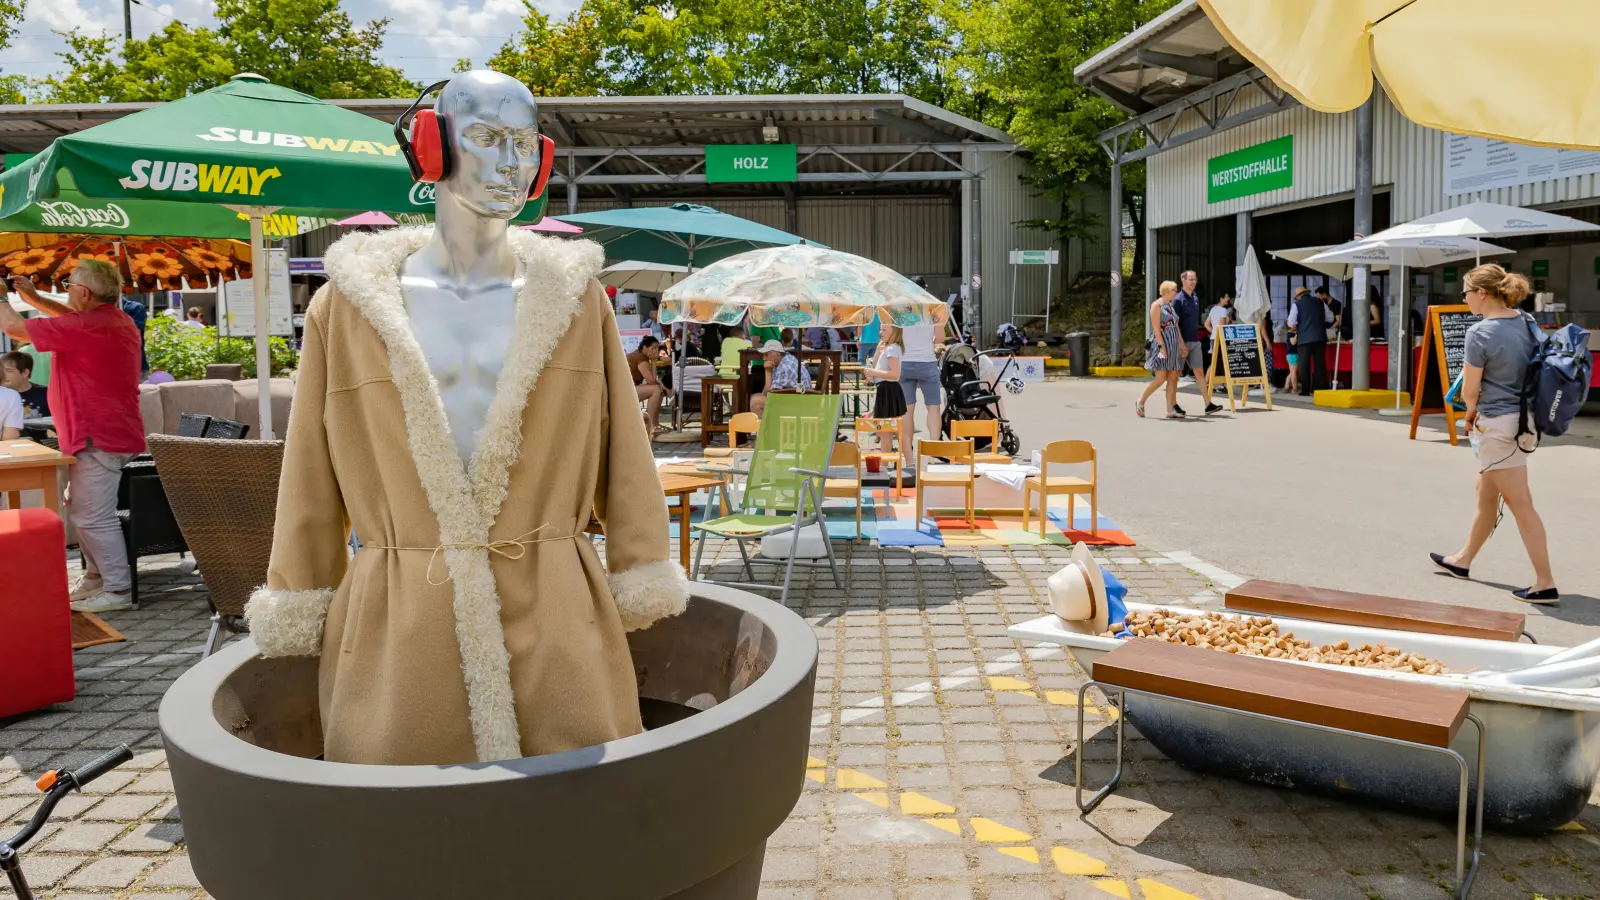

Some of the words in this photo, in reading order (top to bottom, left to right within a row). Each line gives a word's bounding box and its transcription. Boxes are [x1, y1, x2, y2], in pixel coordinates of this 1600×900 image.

[196, 127, 400, 157] SUBWAY
[118, 159, 282, 196] SUBWAY
[733, 157, 769, 169] HOLZ
[1212, 154, 1288, 187] WERTSTOFFHALLE
